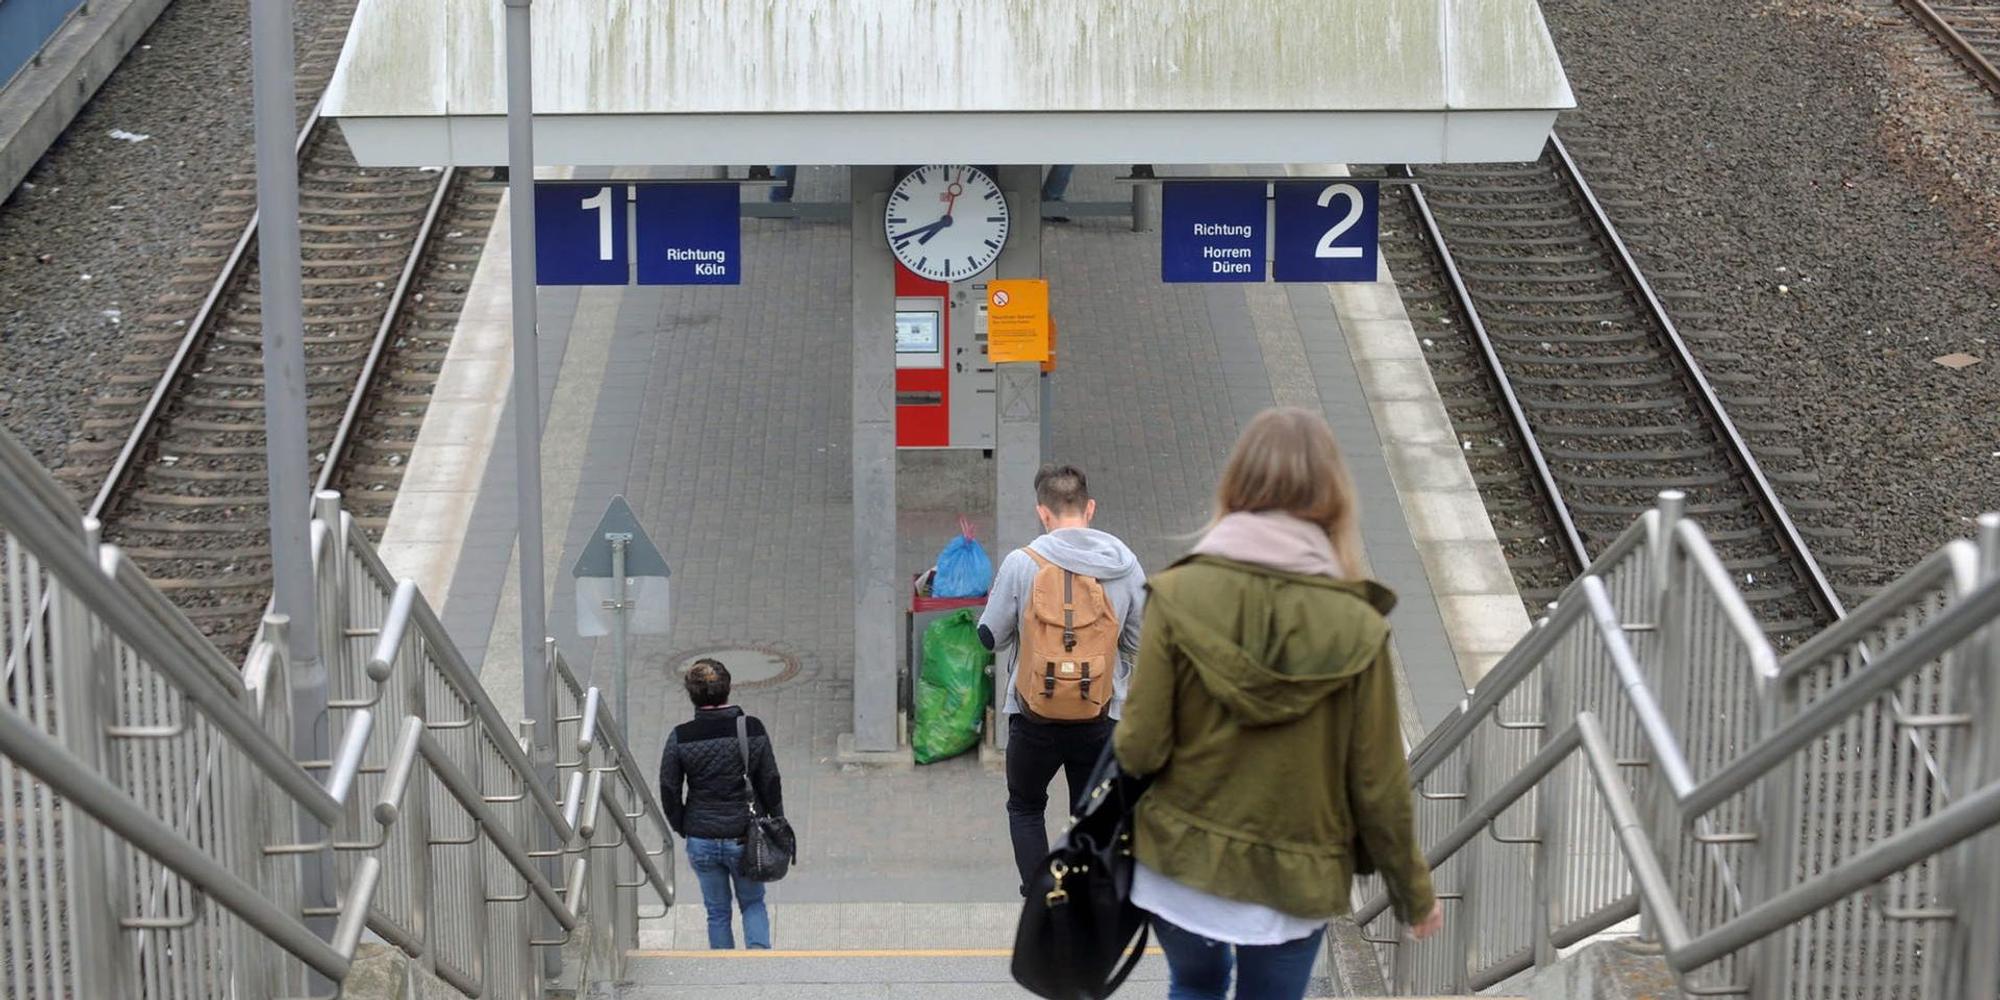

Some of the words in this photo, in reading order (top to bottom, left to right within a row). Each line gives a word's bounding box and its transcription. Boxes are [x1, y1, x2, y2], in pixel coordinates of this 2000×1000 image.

[582, 187, 613, 260] 1
[1315, 184, 1364, 258] 2
[1194, 223, 1252, 239] Richtung
[667, 248, 725, 263] Richtung
[1203, 246, 1252, 259] Horrem
[695, 262, 726, 276] Köln
[1212, 260, 1252, 273] Düren
